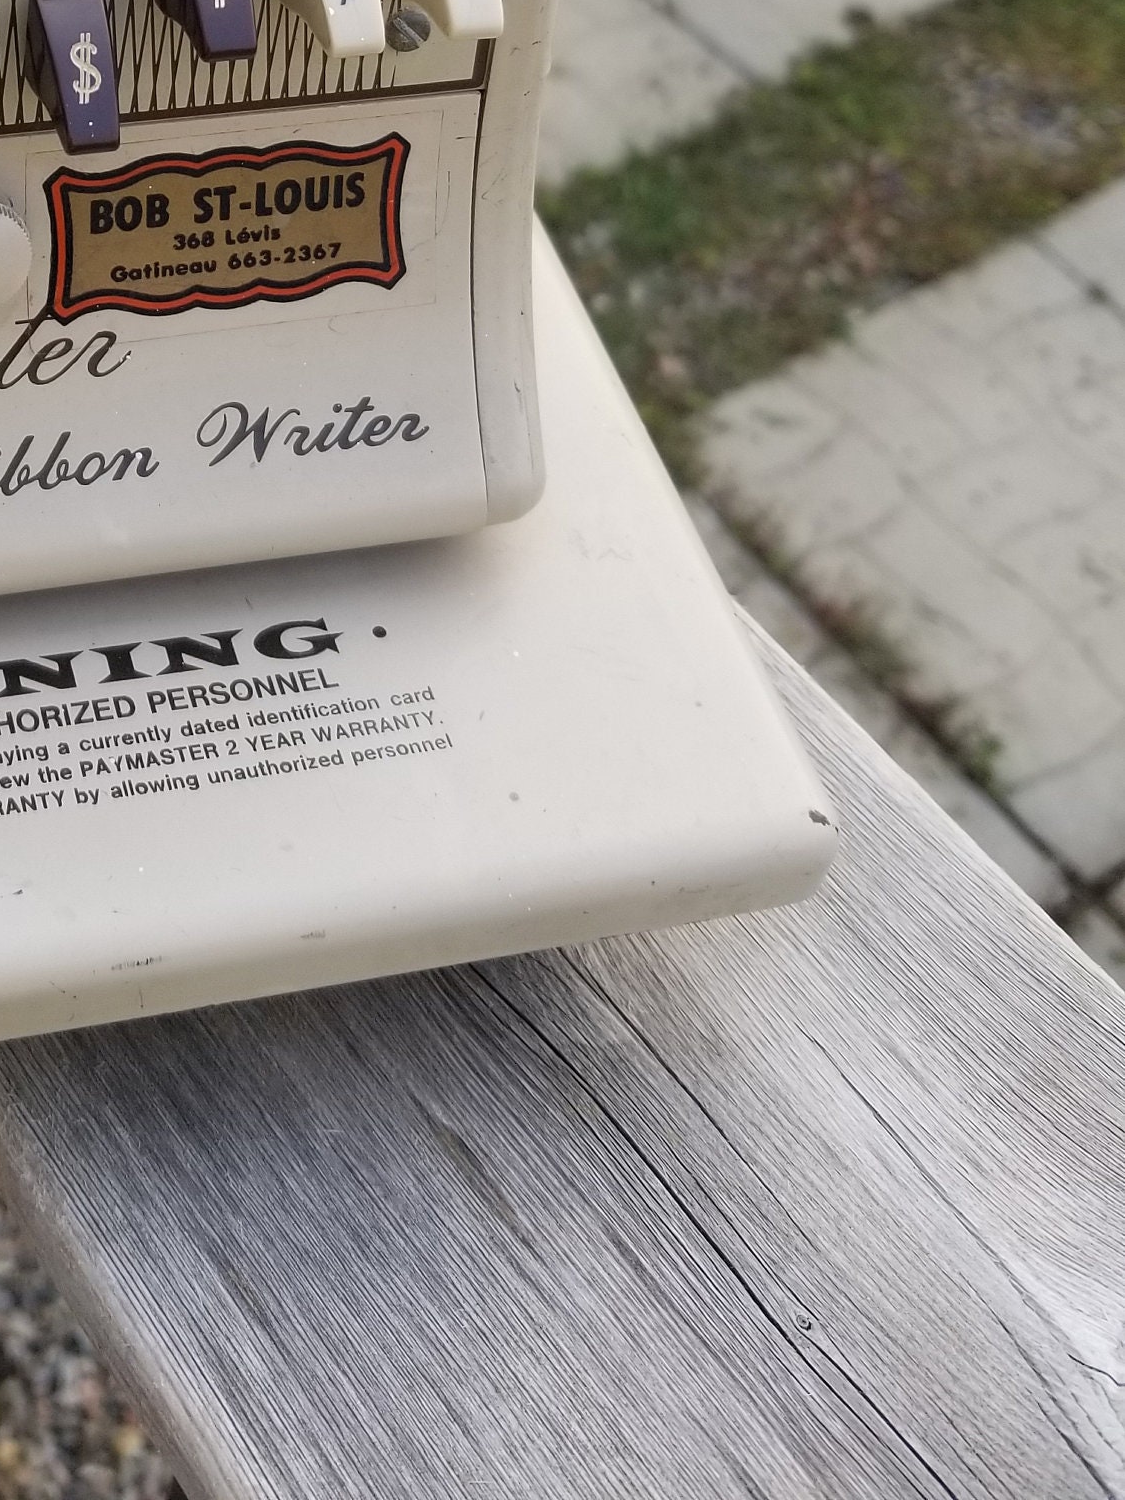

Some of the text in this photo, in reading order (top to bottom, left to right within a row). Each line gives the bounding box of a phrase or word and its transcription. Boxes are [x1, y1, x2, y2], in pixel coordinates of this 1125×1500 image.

[70, 33, 102, 104] $
[89, 172, 366, 234] BOB ST-LOUIS
[110, 242, 342, 283] Gatineau 663-2367
[173, 224, 281, 250] 368 Lévis
[196, 394, 430, 467] Writer
[57, 741, 70, 756] a
[78, 722, 172, 752] currently
[180, 714, 240, 738] dated
[246, 695, 380, 729] identification
[390, 686, 435, 707] card
[146, 667, 340, 715] PERSONNEL
[37, 765, 73, 786] the
[79, 740, 220, 778] PAYMASTER
[225, 739, 240, 756] 2
[244, 729, 306, 753] YEAR
[74, 787, 100, 806] by
[110, 772, 200, 800] allowing
[207, 750, 344, 785] unauthorized
[351, 732, 453, 767] personnel
